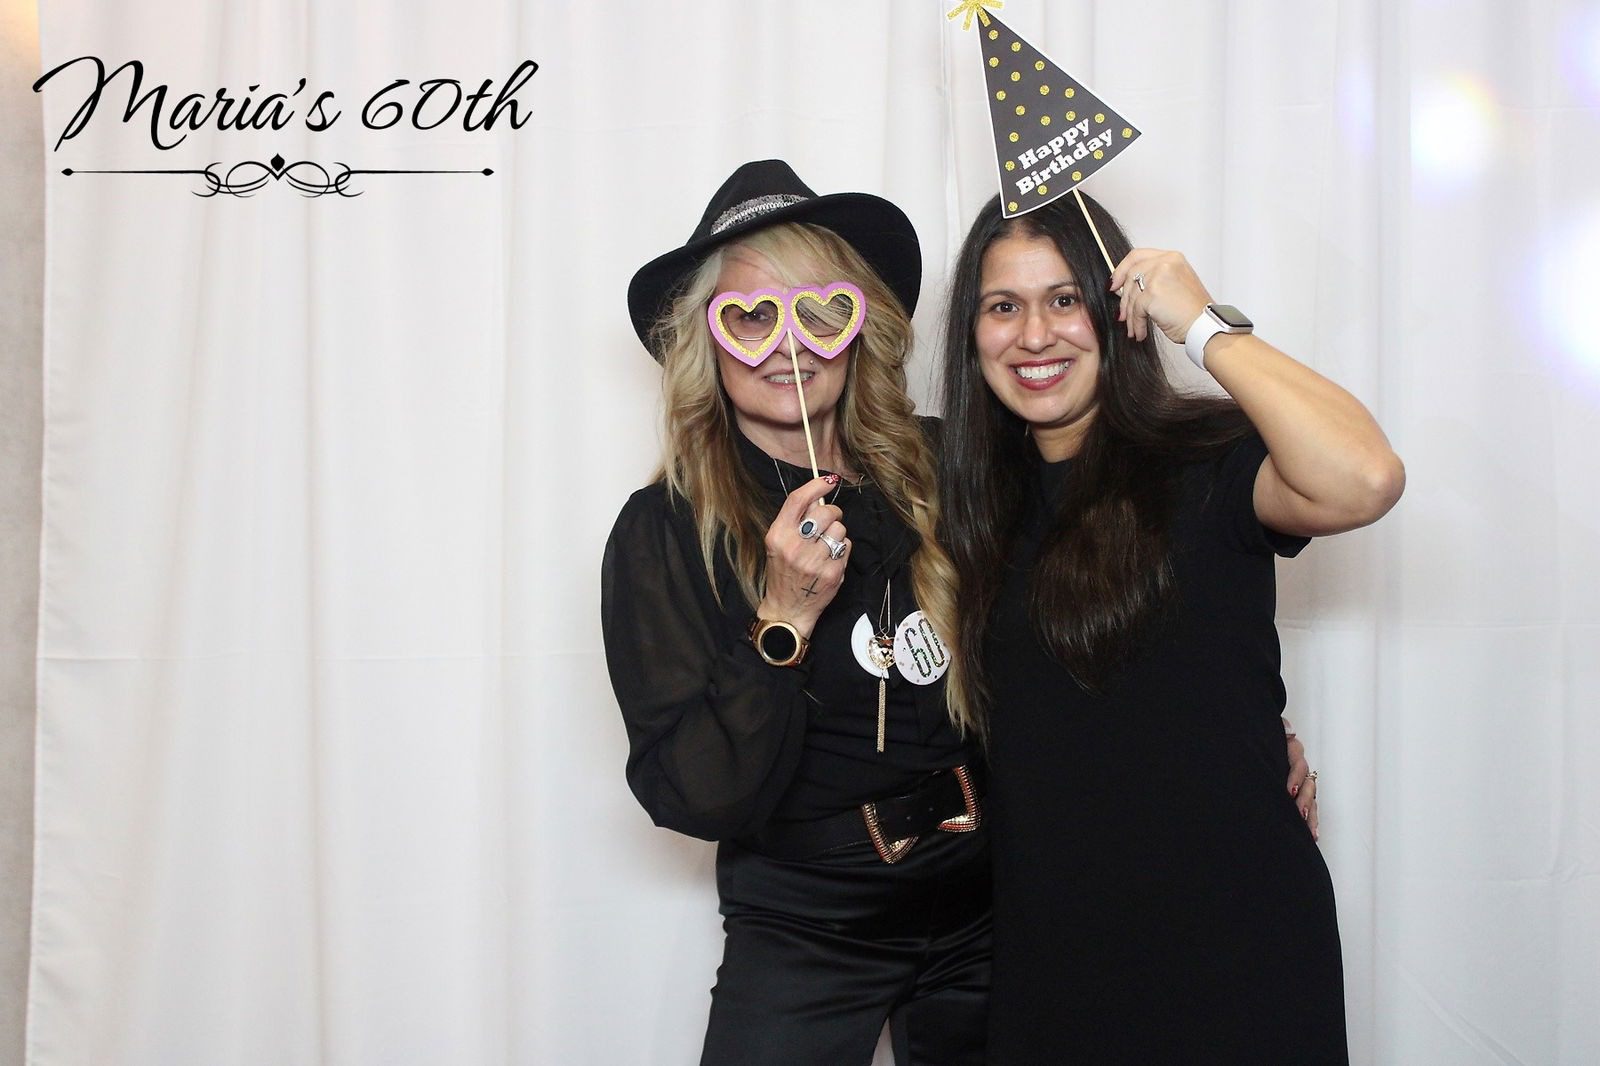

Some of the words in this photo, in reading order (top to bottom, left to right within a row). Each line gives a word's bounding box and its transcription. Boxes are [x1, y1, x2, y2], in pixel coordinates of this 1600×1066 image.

[1015, 128, 1113, 196] Birthday
[1017, 118, 1090, 170] Happy
[904, 617, 945, 678] 60
